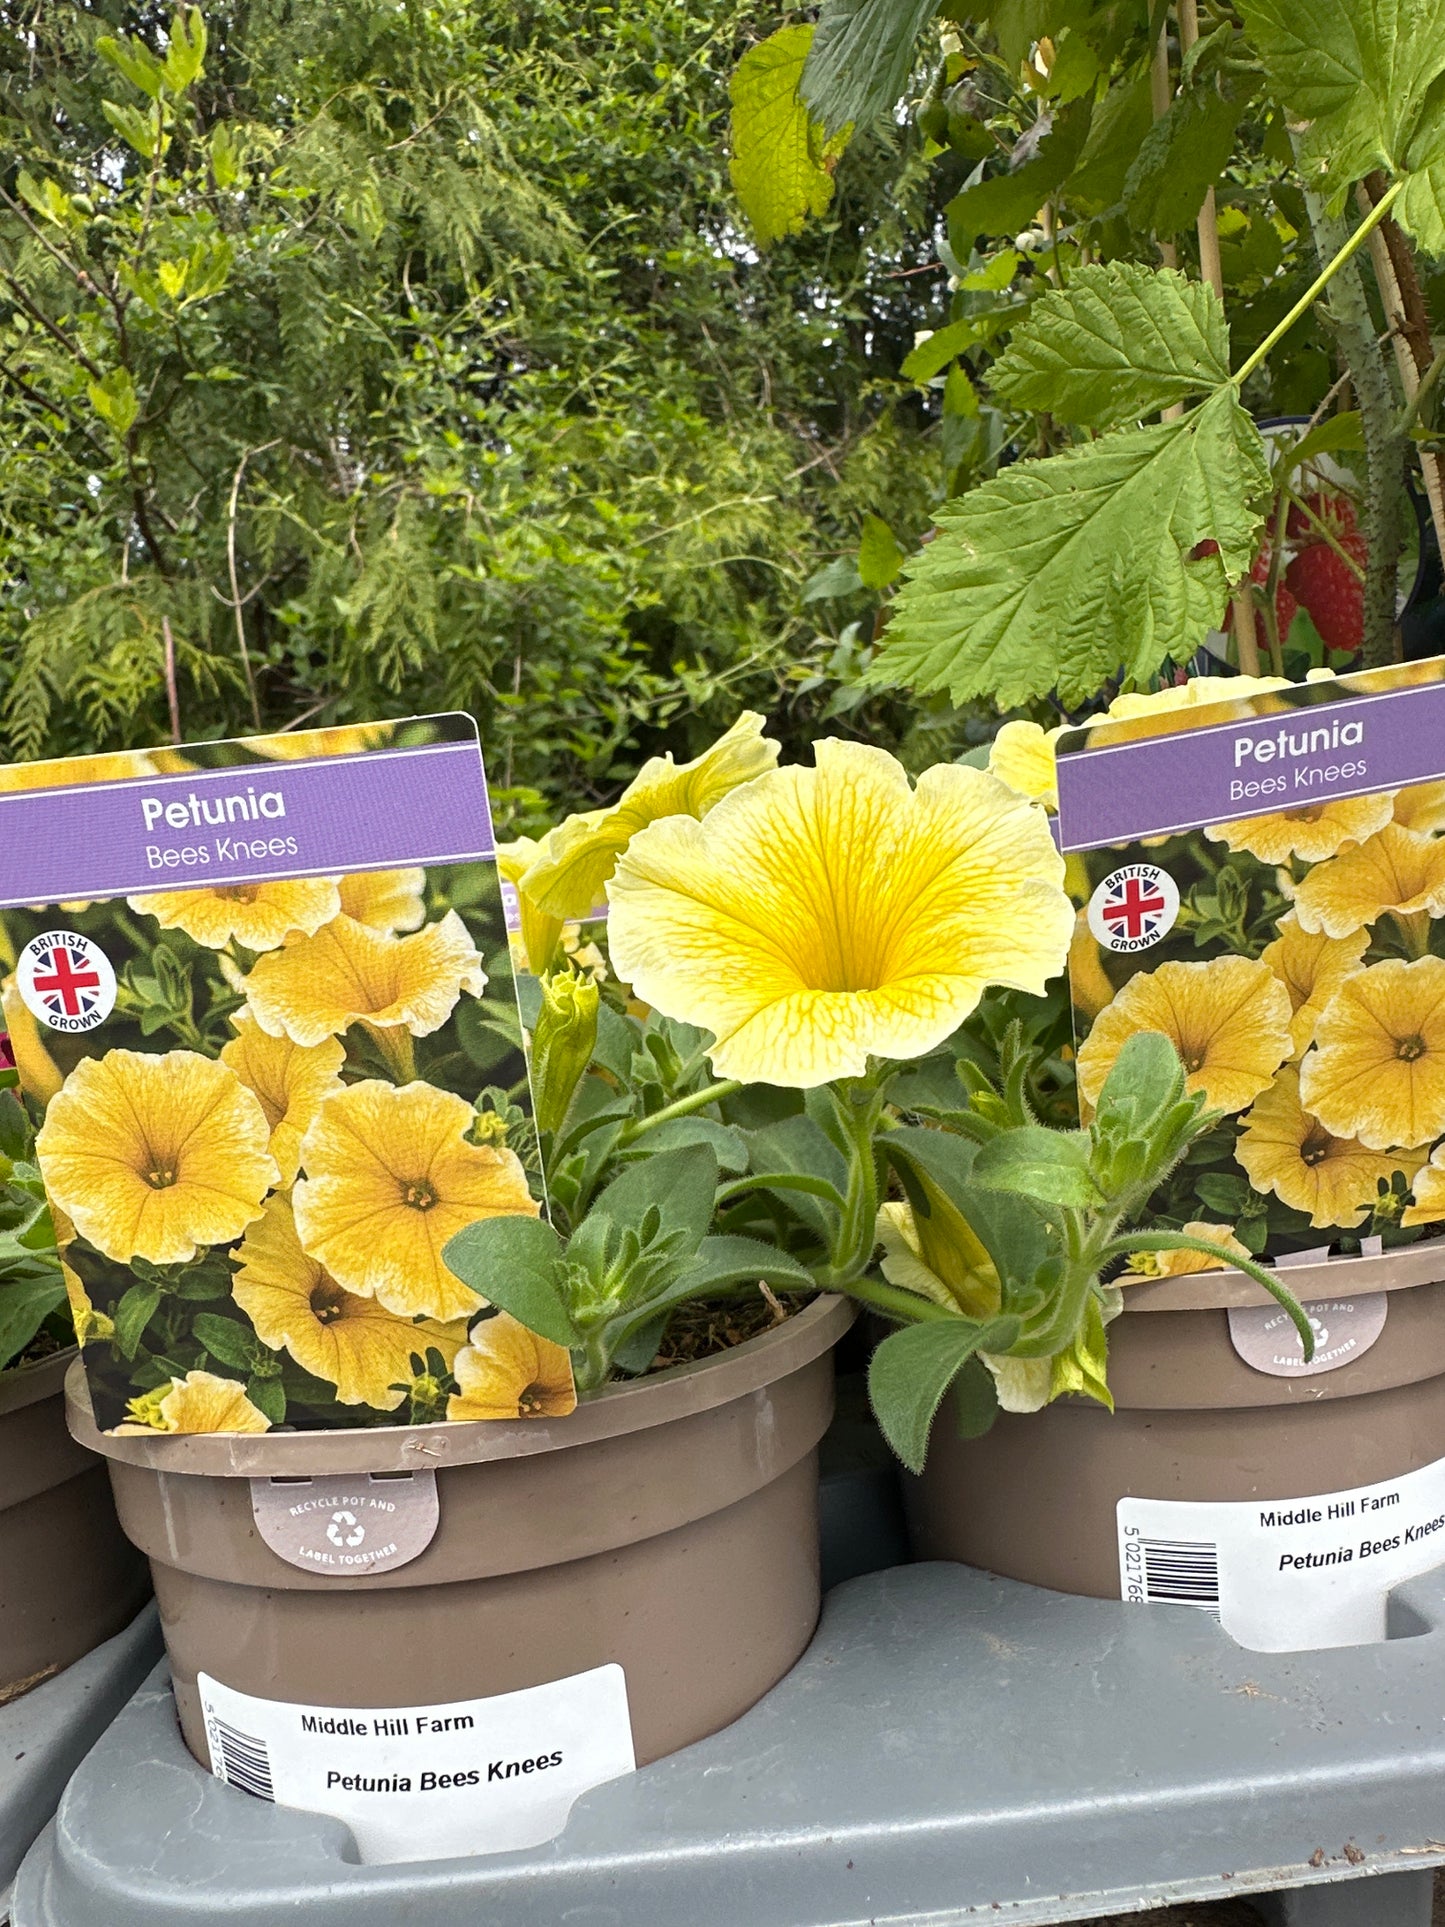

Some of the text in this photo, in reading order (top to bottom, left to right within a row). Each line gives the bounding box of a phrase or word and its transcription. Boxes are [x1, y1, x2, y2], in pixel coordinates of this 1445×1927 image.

[1234, 719, 1364, 768] Petunia
[1230, 759, 1367, 801] Bees Knees
[140, 787, 286, 831] Petunia
[146, 836, 298, 869] Bees Knees
[1105, 866, 1160, 889] BRITISH
[29, 933, 88, 957] BRITISH
[1110, 929, 1161, 951] GROWN
[48, 1009, 103, 1030] GROWN
[1310, 1303, 1330, 1314] POT
[1332, 1303, 1354, 1313] AND
[1308, 1338, 1357, 1365] OGETHER
[289, 1496, 396, 1517] RECYCLE POT AND
[1259, 1492, 1400, 1527] Middle Hill Farm
[299, 1543, 398, 1565] LABEL TOGETHER
[1279, 1514, 1445, 1571] Petunia Bees Knees
[301, 1714, 475, 1737] Middle Hill Farm
[326, 1750, 563, 1793] Petunia Bees Knees
